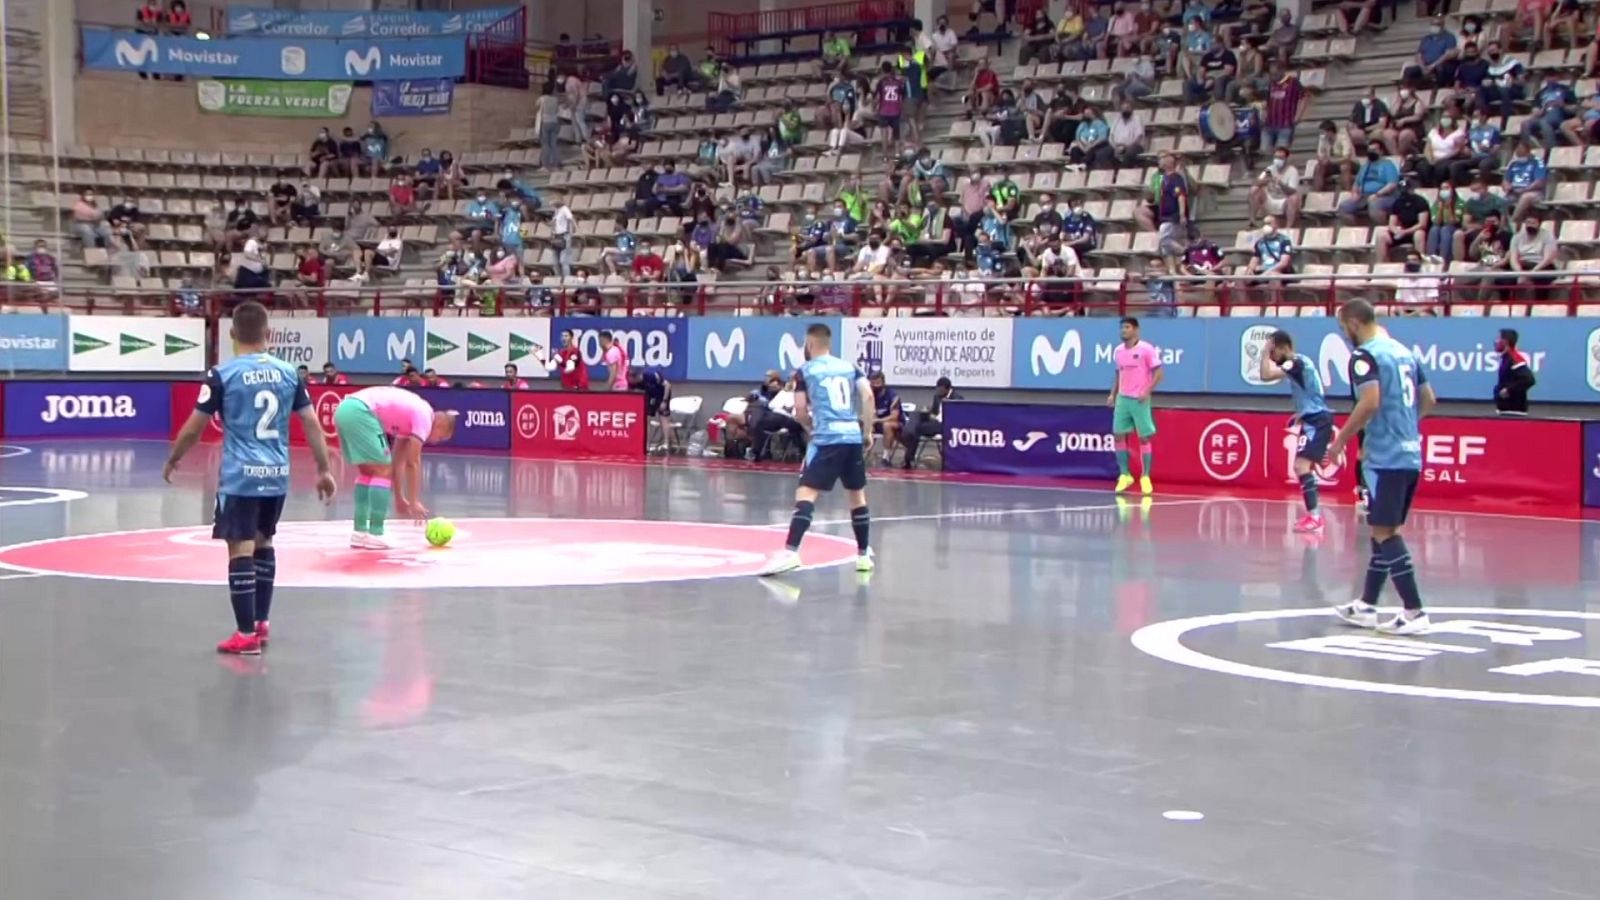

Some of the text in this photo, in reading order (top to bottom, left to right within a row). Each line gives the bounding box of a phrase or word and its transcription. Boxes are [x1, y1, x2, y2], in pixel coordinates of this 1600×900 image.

[261, 21, 329, 34] Corredor
[370, 22, 431, 36] Corredor
[168, 48, 240, 65] Movistar
[389, 54, 443, 67] Movistar
[884, 85, 899, 101] 25
[0, 332, 59, 349] ovistar
[894, 327, 996, 344] Ayuntamiento de
[263, 345, 314, 363] EMTRO
[944, 346, 959, 362] DE
[960, 346, 996, 362] ARDOZ
[1094, 343, 1184, 365] Mtar
[1413, 343, 1546, 372] Movisr
[242, 370, 283, 385] CECILIO
[940, 366, 951, 377] de
[954, 366, 996, 378] Deportes
[819, 376, 851, 411] 10
[1398, 364, 1415, 408] 5
[253, 389, 280, 441] 2
[587, 411, 637, 428] RFEF
[592, 429, 629, 438] FUTSAL
[1211, 434, 1239, 448] RF
[1422, 434, 1487, 465] EF
[1211, 452, 1239, 465] EF
[1423, 469, 1467, 483] SAL
